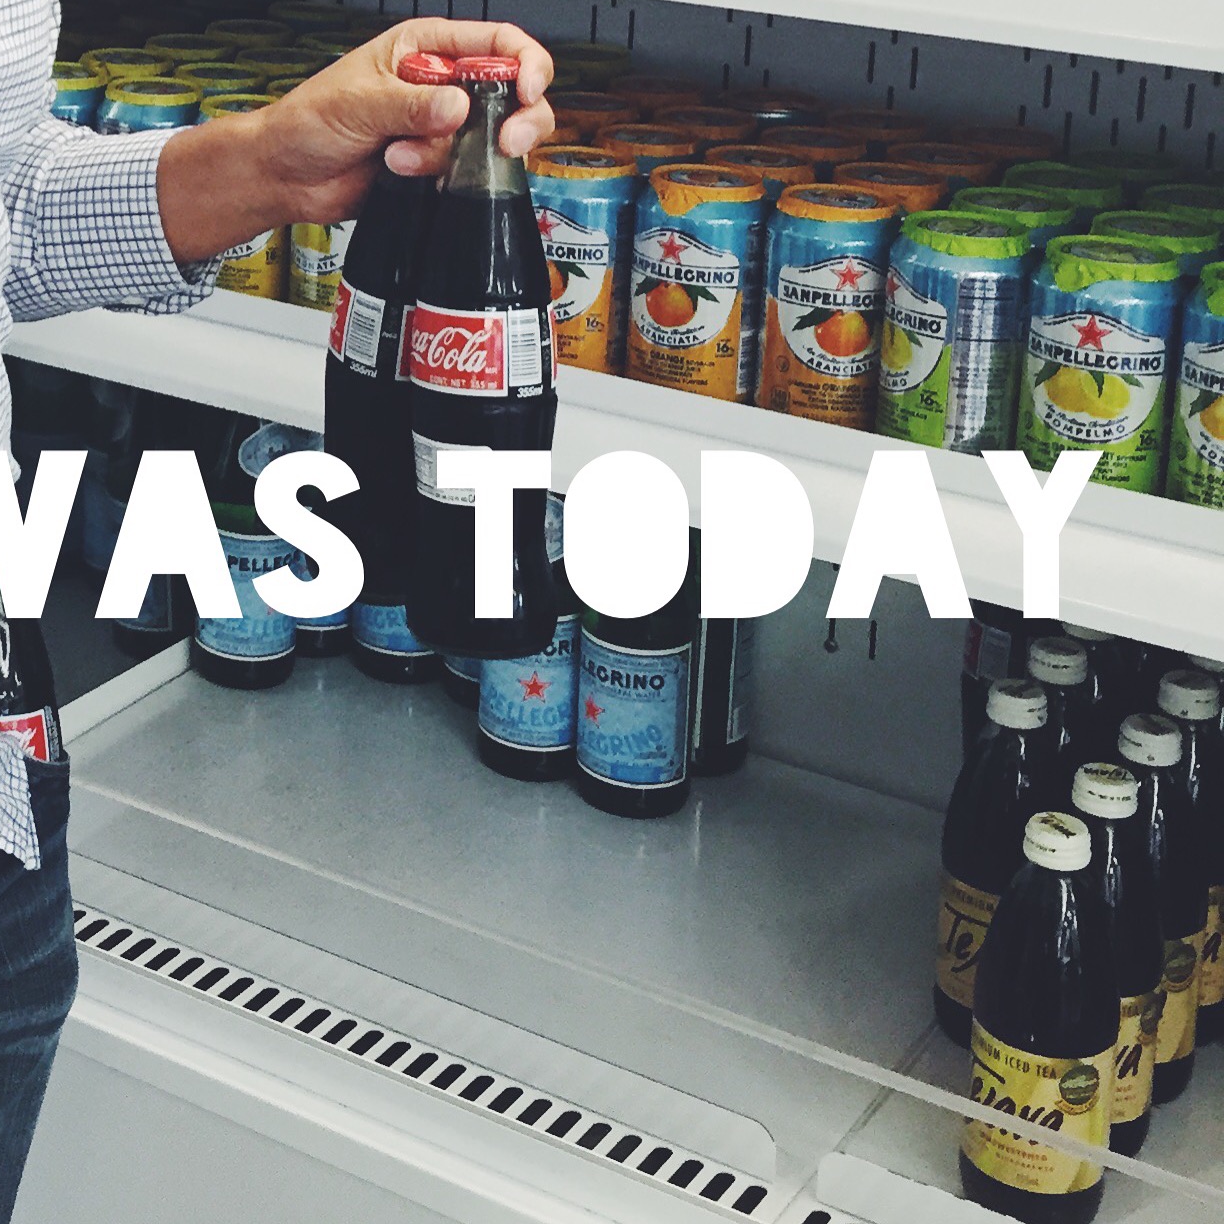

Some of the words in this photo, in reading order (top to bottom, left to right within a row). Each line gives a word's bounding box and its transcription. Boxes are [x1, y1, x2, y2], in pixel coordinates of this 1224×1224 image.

[1030, 336, 1162, 372] SANPELLEGRINO
[1044, 411, 1126, 438] POMPELMO
[1004, 1053, 1031, 1074] ICED
[1035, 1064, 1058, 1080] TEA
